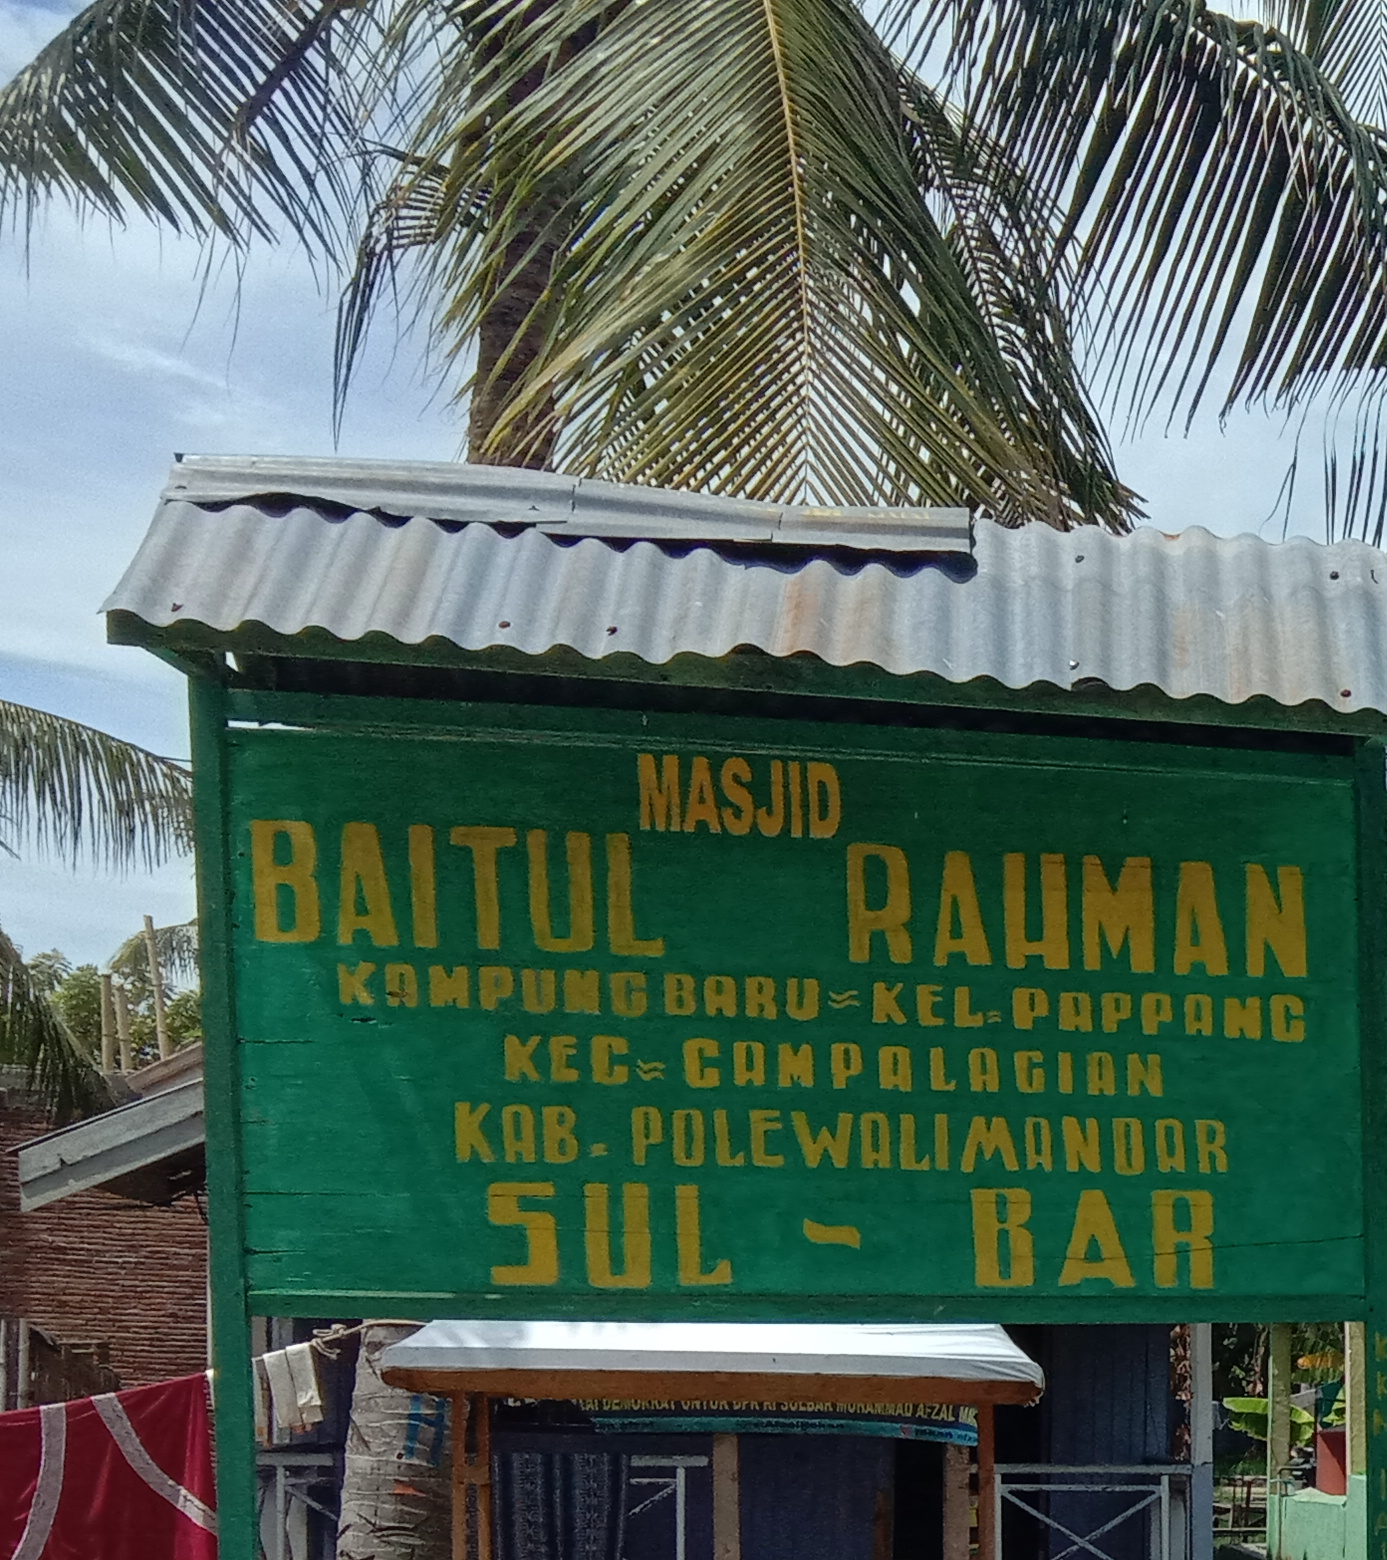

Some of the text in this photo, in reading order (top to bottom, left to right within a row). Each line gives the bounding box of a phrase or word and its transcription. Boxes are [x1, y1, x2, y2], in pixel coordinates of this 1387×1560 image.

[637, 752, 842, 838] MASJID
[250, 819, 1308, 978] BAITUL RAHMAN
[1011, 986, 1307, 1043] PAPPANG
[682, 1037, 1164, 1097] CAMPALAGIAN
[486, 1181, 732, 1288] SUL
[969, 1186, 1216, 1289] BAR
[914, 1402, 956, 1422] AFZAL
